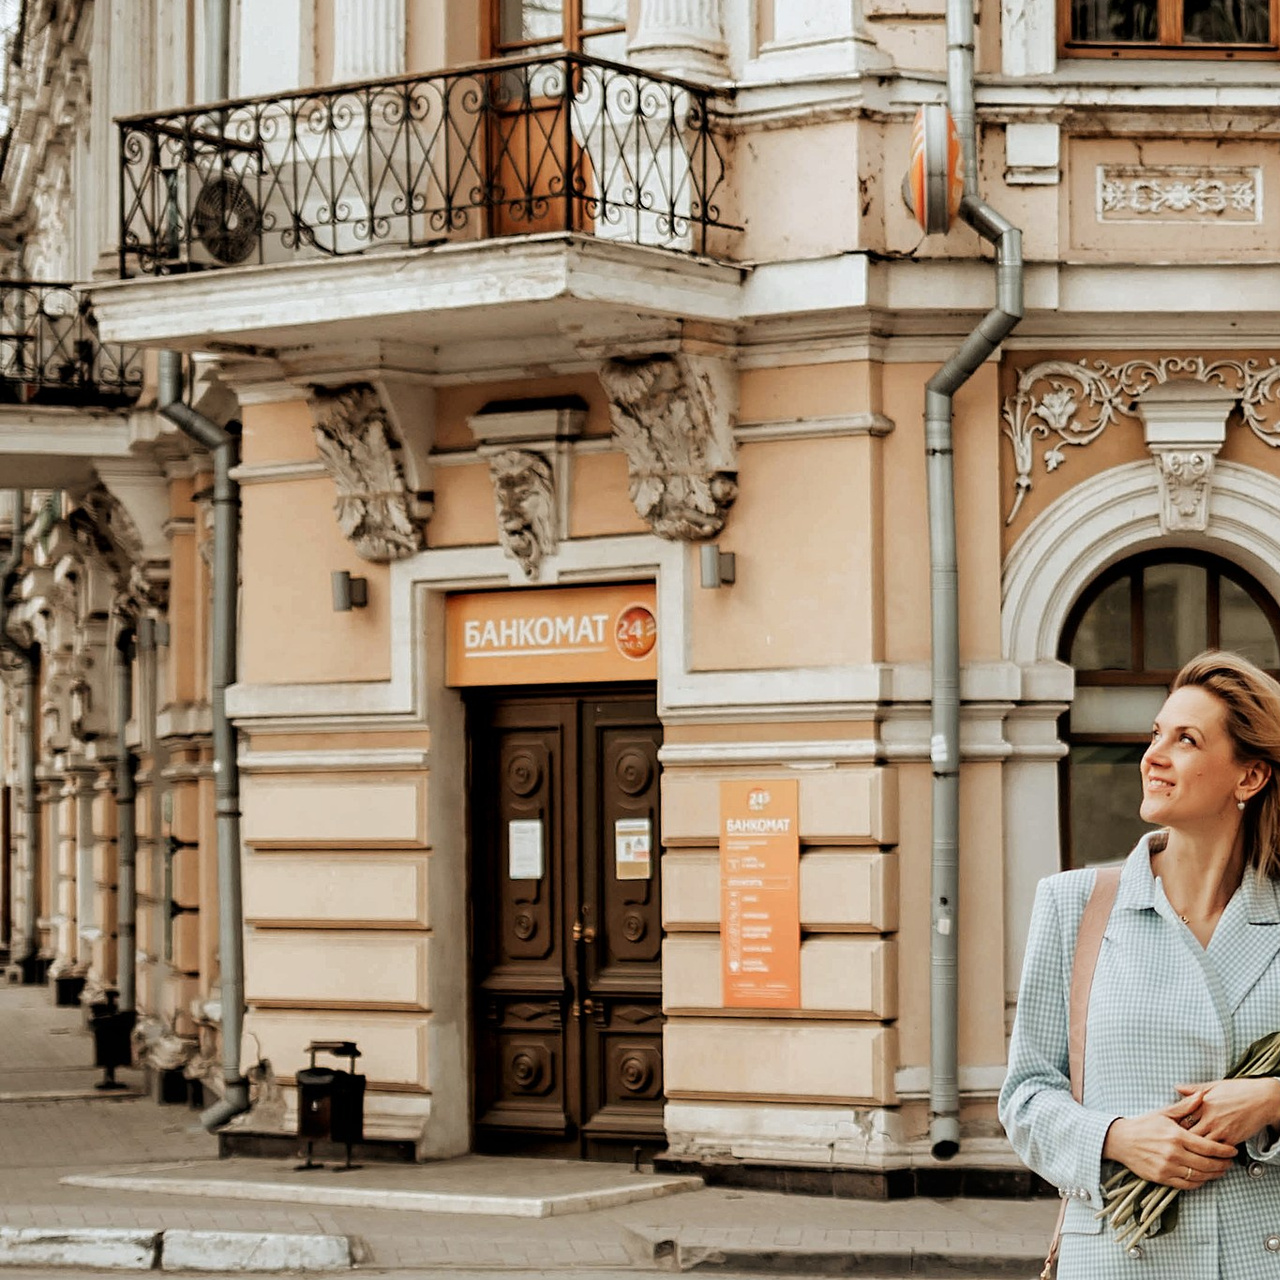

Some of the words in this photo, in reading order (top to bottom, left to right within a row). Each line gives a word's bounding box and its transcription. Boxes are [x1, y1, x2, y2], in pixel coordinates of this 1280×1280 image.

[465, 615, 609, 648] БАНКОМАТ
[618, 620, 642, 638] 24
[726, 818, 790, 832] БАНКОМАТ
